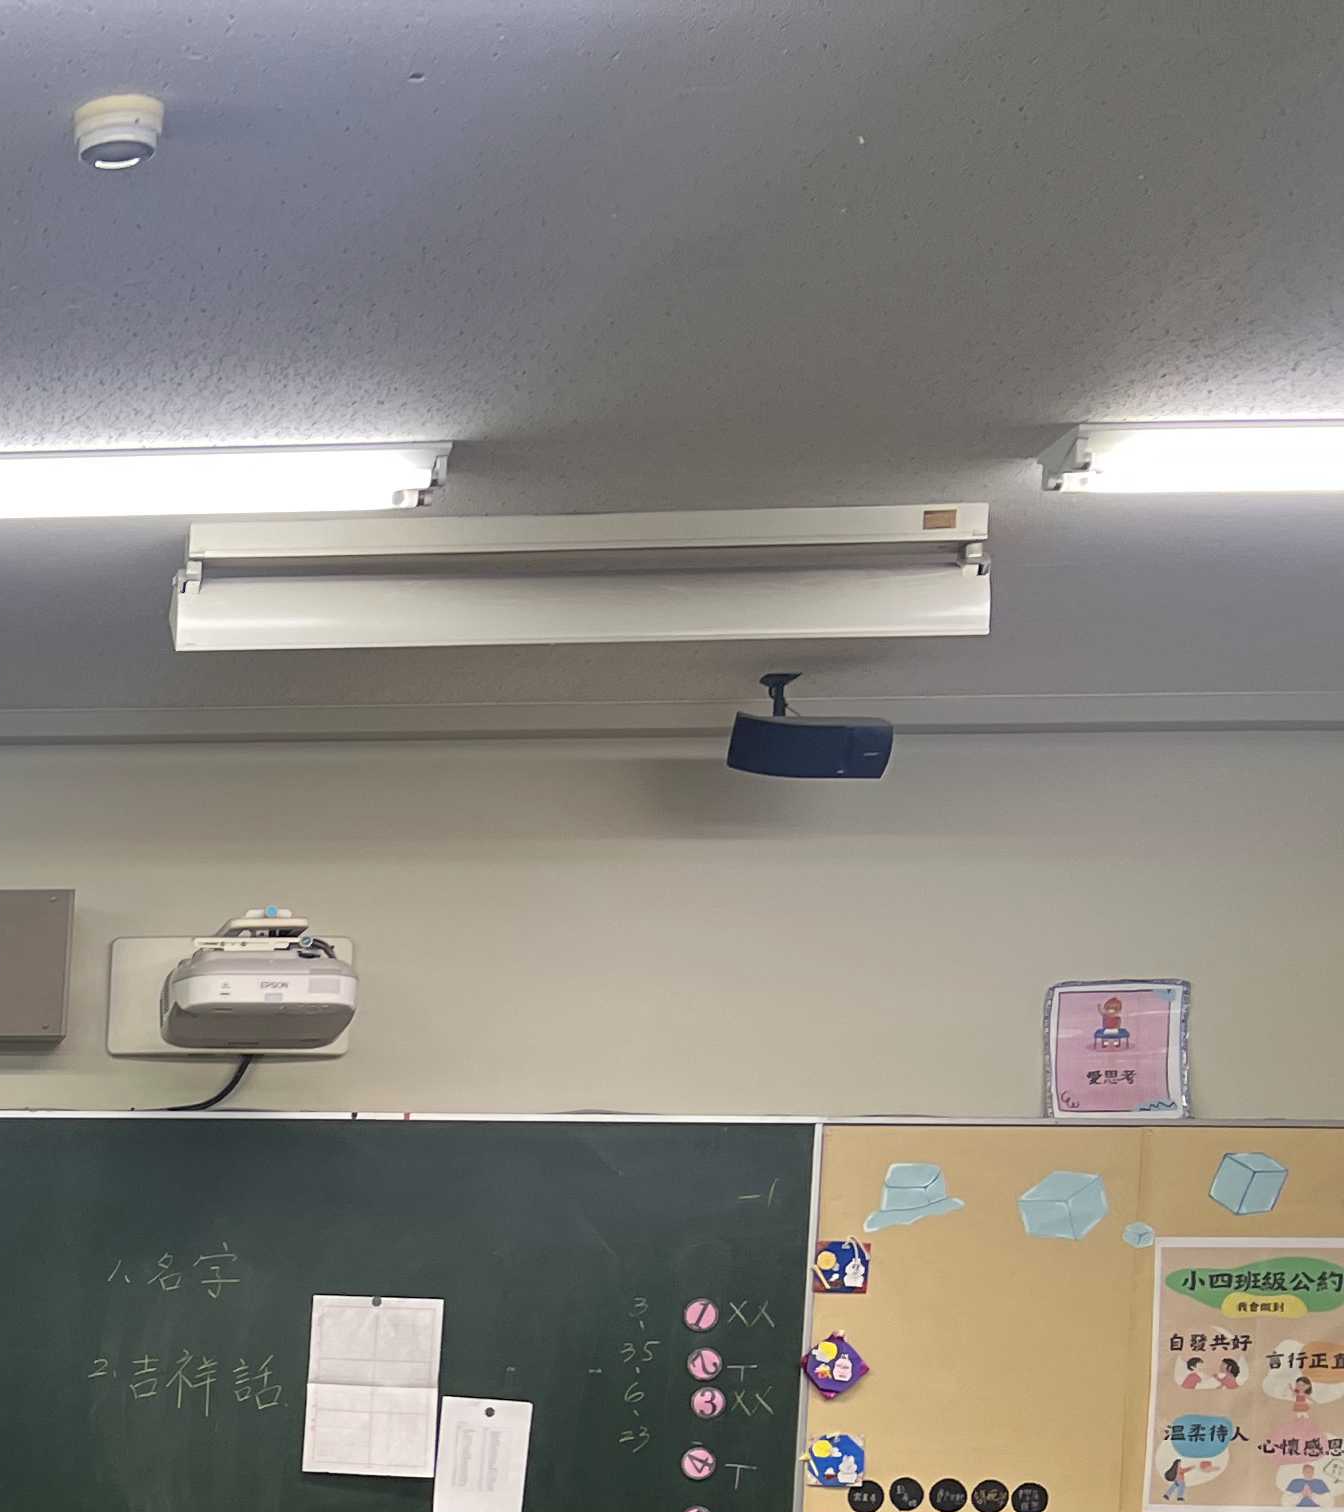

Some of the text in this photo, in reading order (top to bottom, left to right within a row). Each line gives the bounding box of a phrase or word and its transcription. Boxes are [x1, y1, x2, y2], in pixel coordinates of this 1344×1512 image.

[1181, 1270, 1344, 1293] 小四班級公約
[1169, 1333, 1252, 1352] 自發共好
[1266, 1351, 1344, 1370] 言行正直
[1257, 1438, 1344, 1457] 心懷感恩
